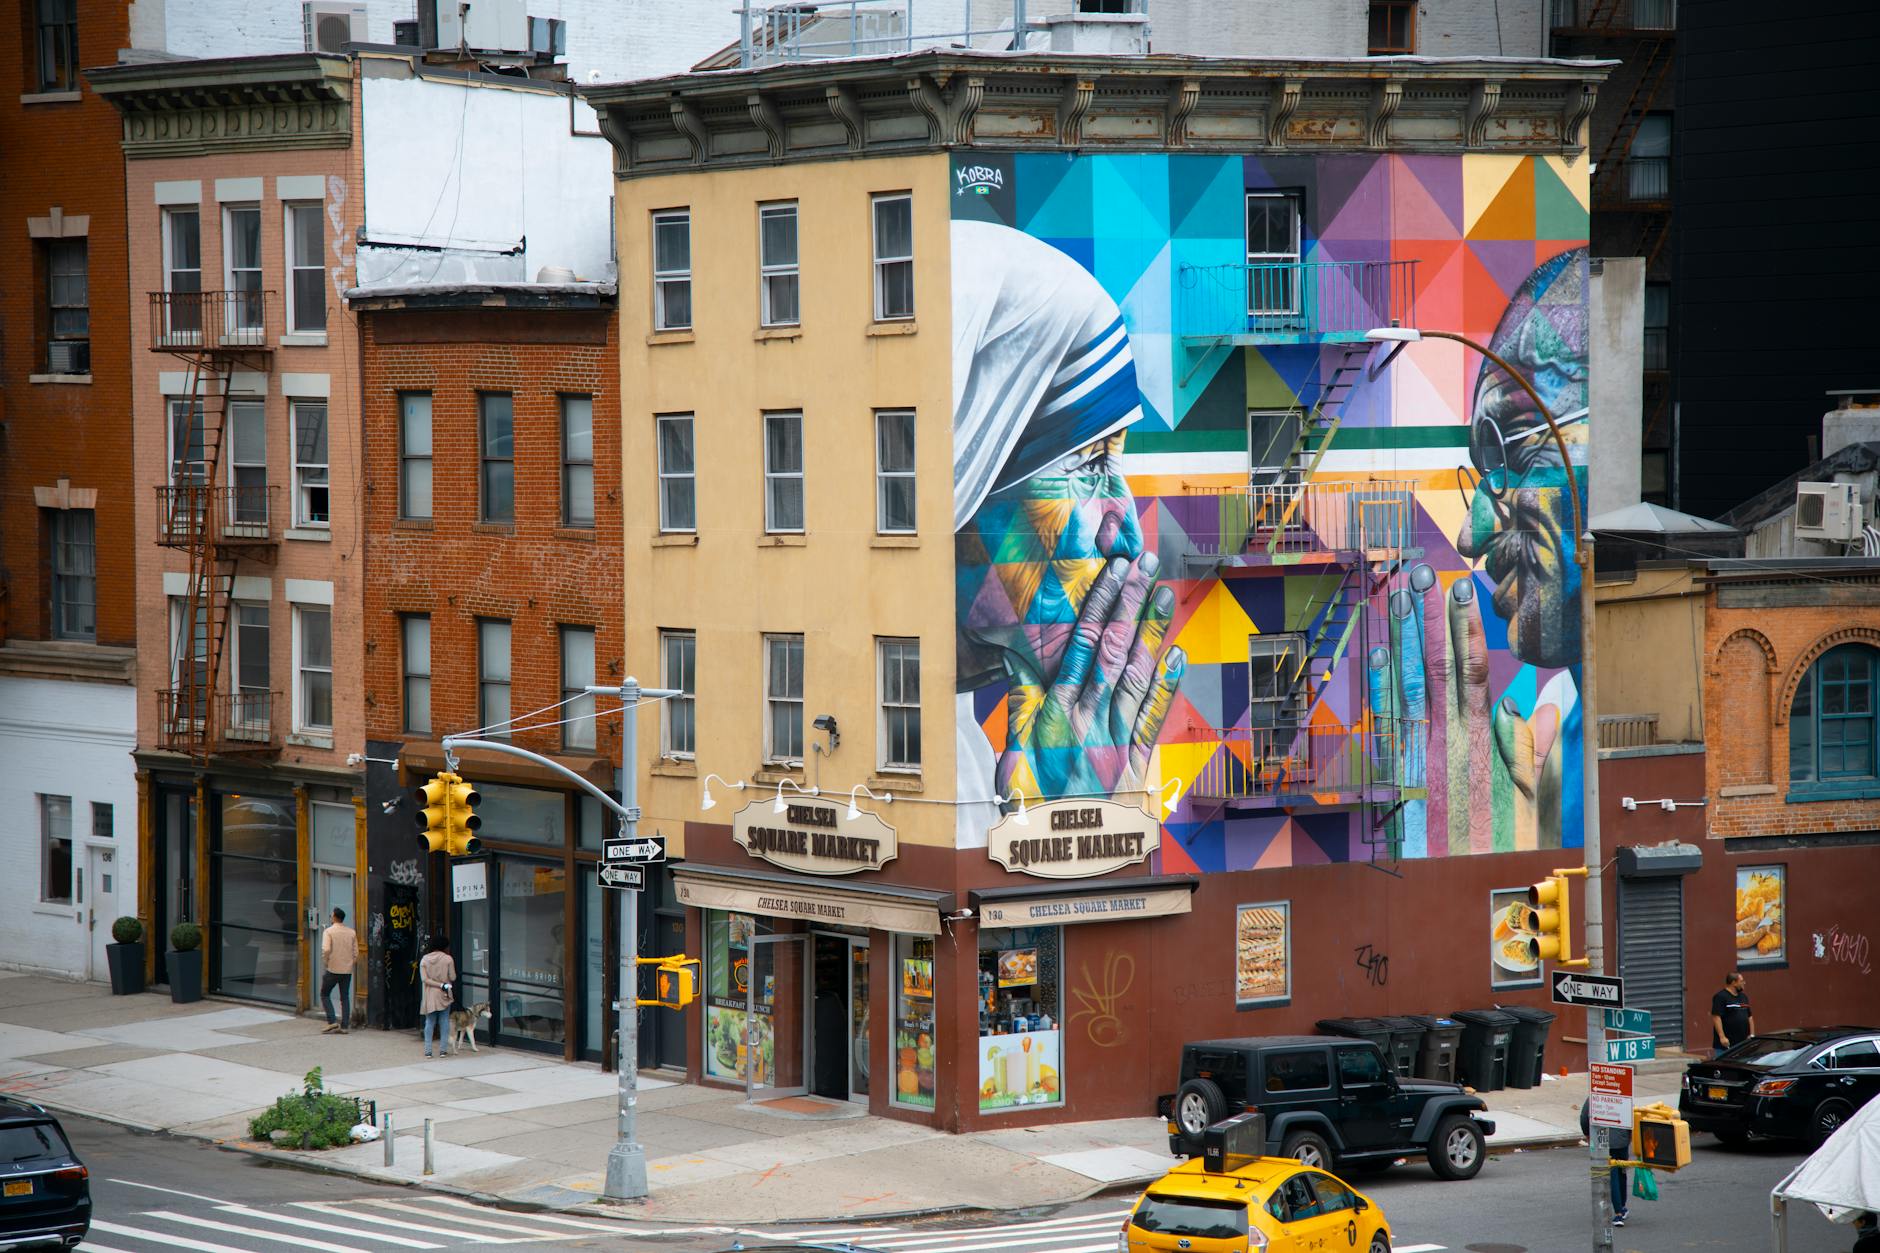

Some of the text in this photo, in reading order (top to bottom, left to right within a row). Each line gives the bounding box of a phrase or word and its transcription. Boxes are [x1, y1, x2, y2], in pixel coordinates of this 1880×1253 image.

[956, 165, 1003, 185] KOBRA
[787, 804, 837, 828] CHELSEA
[1050, 808, 1103, 831] CHELSEA
[612, 844, 657, 857] ONE WAY
[748, 826, 880, 862] SQUARE MARKET
[1009, 832, 1145, 867] SQUARE MARKET
[604, 869, 638, 883] ONE WAY
[456, 883, 485, 893] SPINA
[757, 897, 845, 918] CHELSEA SQUARE MARKET
[988, 909, 1003, 921] 130
[1029, 898, 1147, 918] CHELSEA SQUARE MARKET
[535, 971, 557, 983] BRIDE
[1562, 981, 1614, 999] ONE WAY
[715, 997, 746, 1009] BREAKFAST
[1611, 1009, 1643, 1028] 10 AV
[1609, 1039, 1651, 1060] W 18 ST
[1592, 1065, 1626, 1076] NO STANDING
[1601, 1096, 1623, 1105] PARKING
